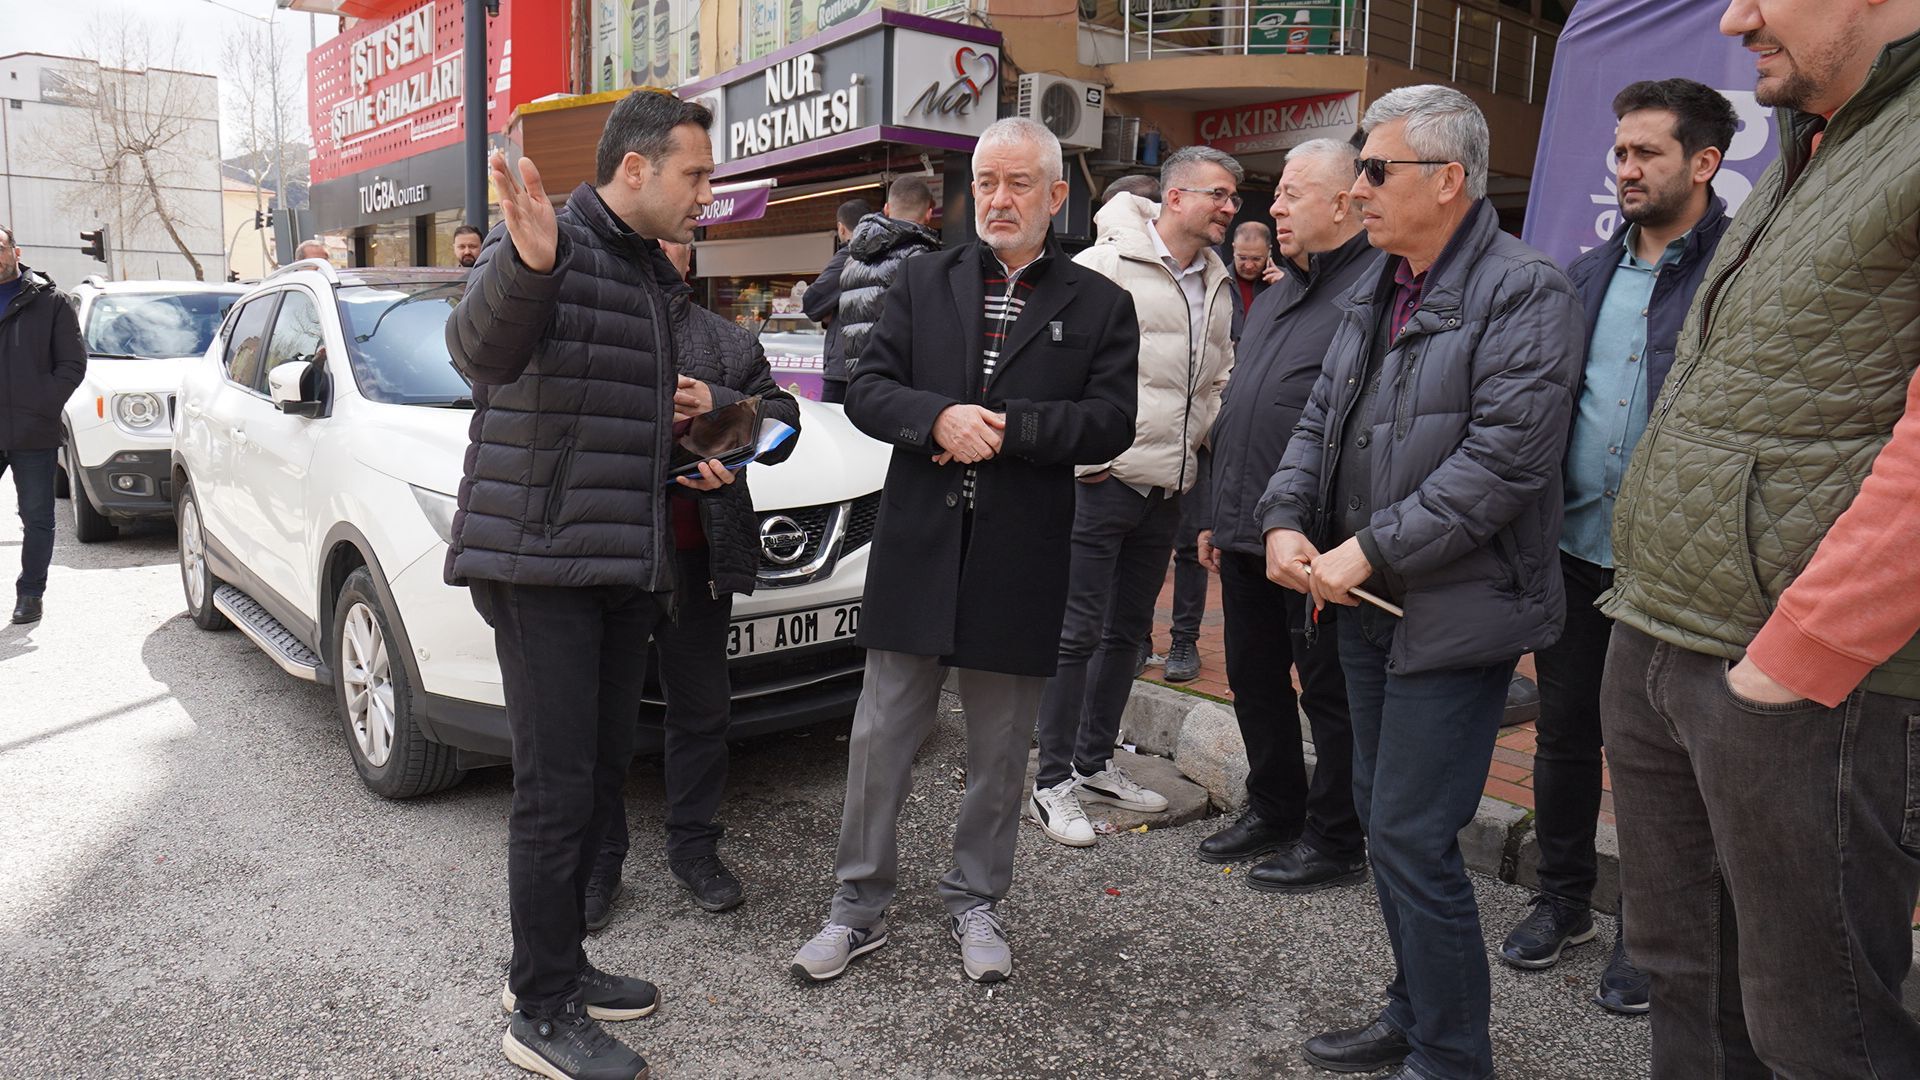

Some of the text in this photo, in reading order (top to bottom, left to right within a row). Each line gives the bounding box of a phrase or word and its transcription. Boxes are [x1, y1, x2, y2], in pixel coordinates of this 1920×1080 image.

[376, 58, 461, 124] CİHAZLARI
[766, 53, 816, 106] NUR
[731, 73, 859, 159] PASTANESİ
[1201, 99, 1353, 145] ÇAKIRKAYA
[359, 175, 425, 214] TUĞBA OUTLET
[763, 533, 804, 548] NISSAN
[727, 605, 861, 656] 31 AOM 20
